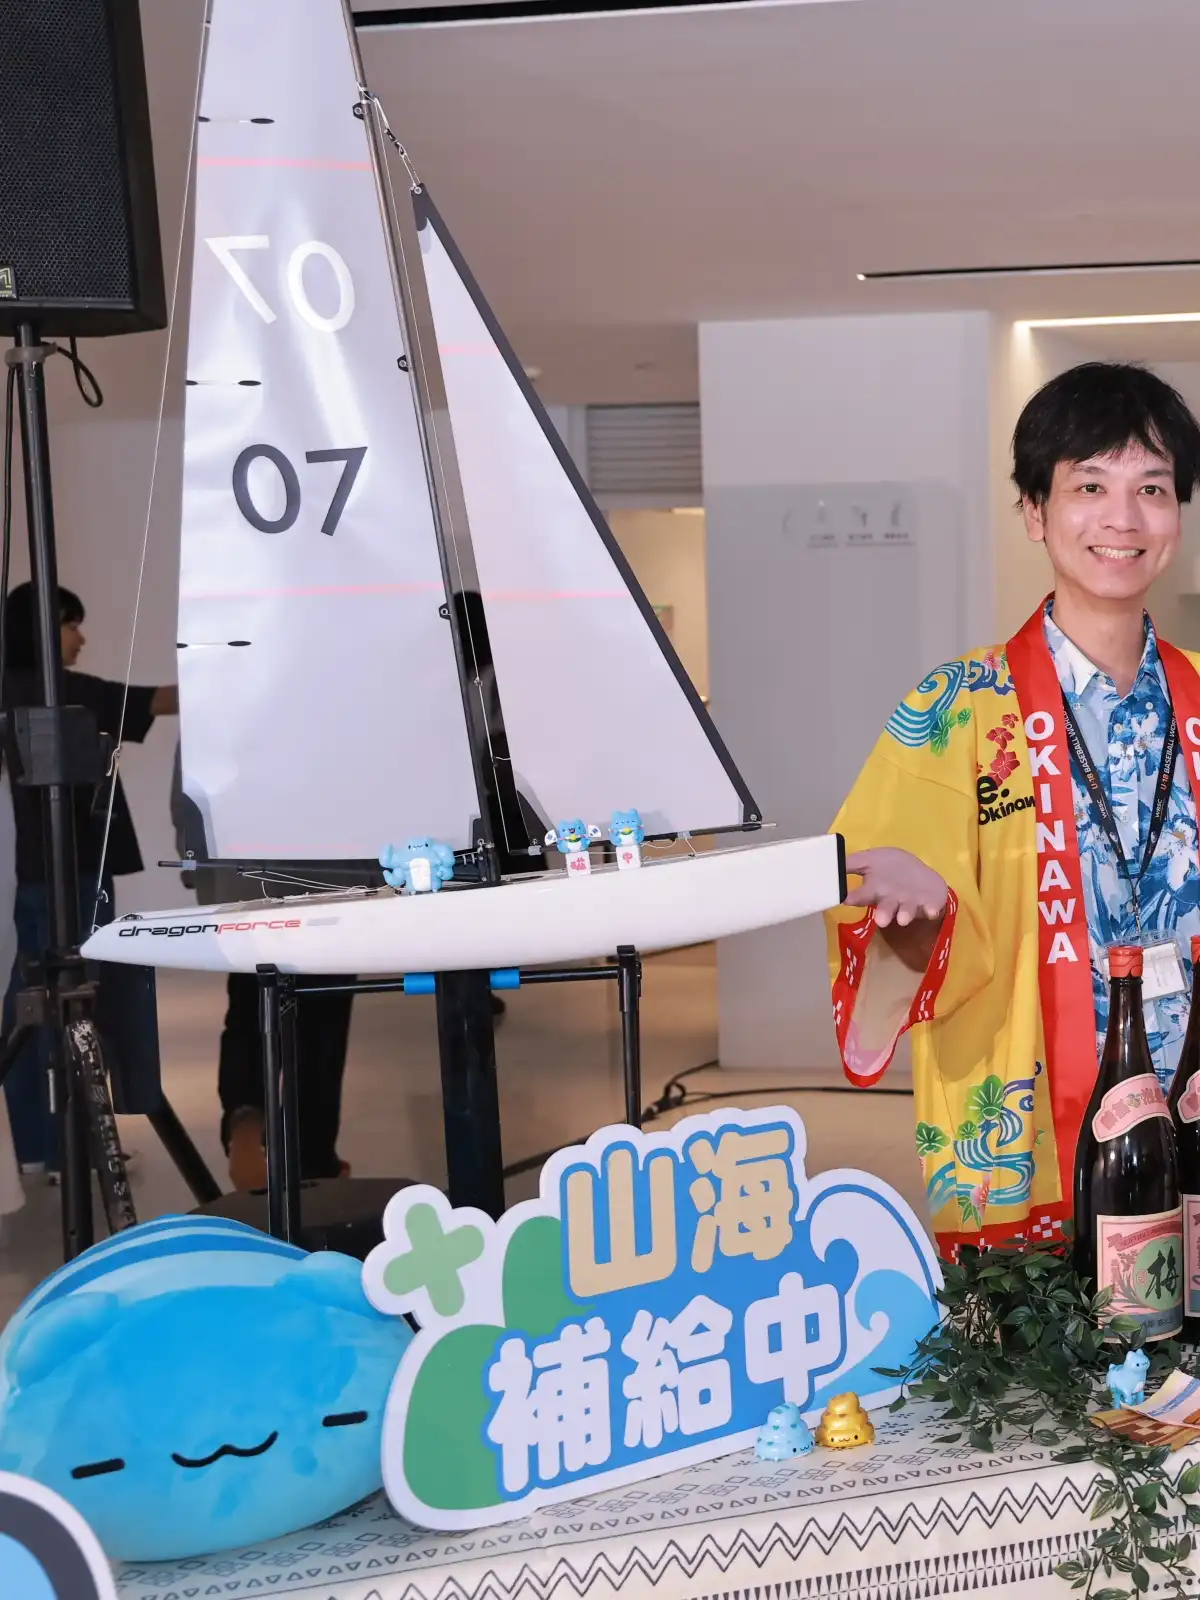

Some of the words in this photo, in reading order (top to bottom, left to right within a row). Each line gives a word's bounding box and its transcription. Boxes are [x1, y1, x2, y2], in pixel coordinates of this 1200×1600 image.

[231, 442, 368, 537] 07
[1072, 736, 1091, 773] BASEBALL
[1164, 739, 1175, 773] BASEBALL
[979, 796, 1036, 825] Okinaw
[1024, 711, 1079, 964] OKINAWA
[118, 919, 301, 938] dragonforce
[566, 1128, 794, 1298] 山海
[1146, 1246, 1180, 1299] 梅
[488, 1272, 842, 1492] 補給中
